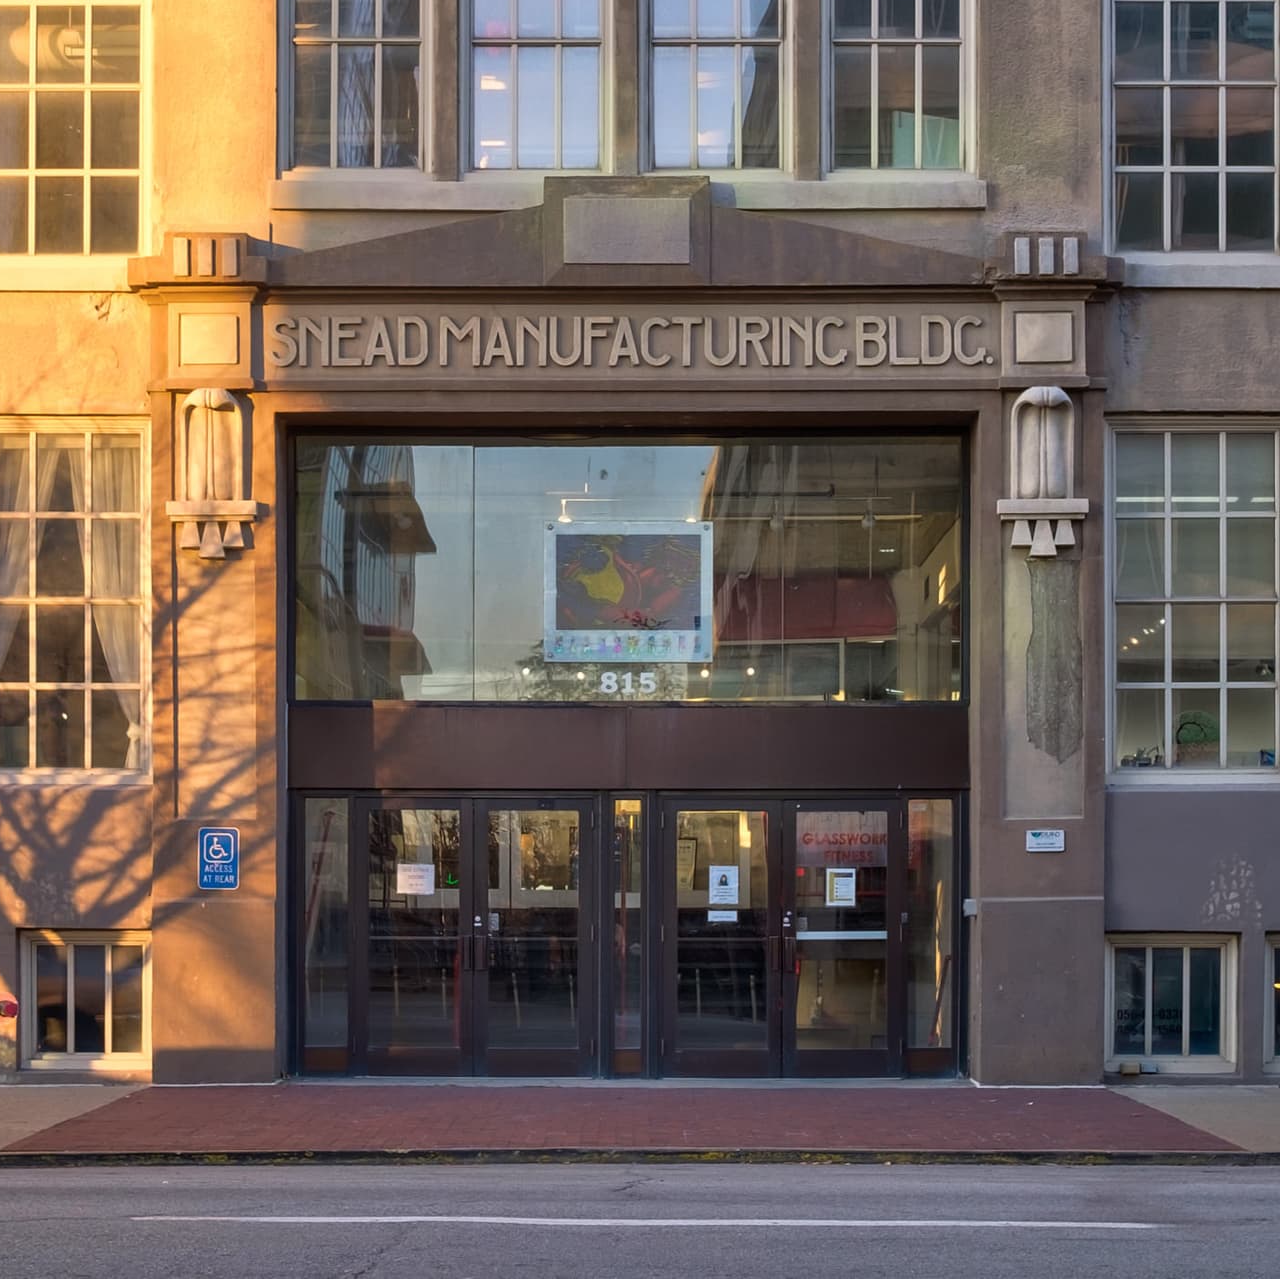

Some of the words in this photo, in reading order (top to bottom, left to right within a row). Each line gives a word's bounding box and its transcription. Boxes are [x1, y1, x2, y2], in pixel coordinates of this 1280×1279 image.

[271, 316, 430, 367] SNEAD
[439, 315, 848, 367] MANUFACTURING
[855, 315, 994, 367] BLDG.
[600, 672, 657, 694] 815
[824, 850, 873, 863] FITNESS
[204, 864, 233, 873] ACCESS
[203, 875, 212, 883] AT
[214, 875, 235, 884] REAR
